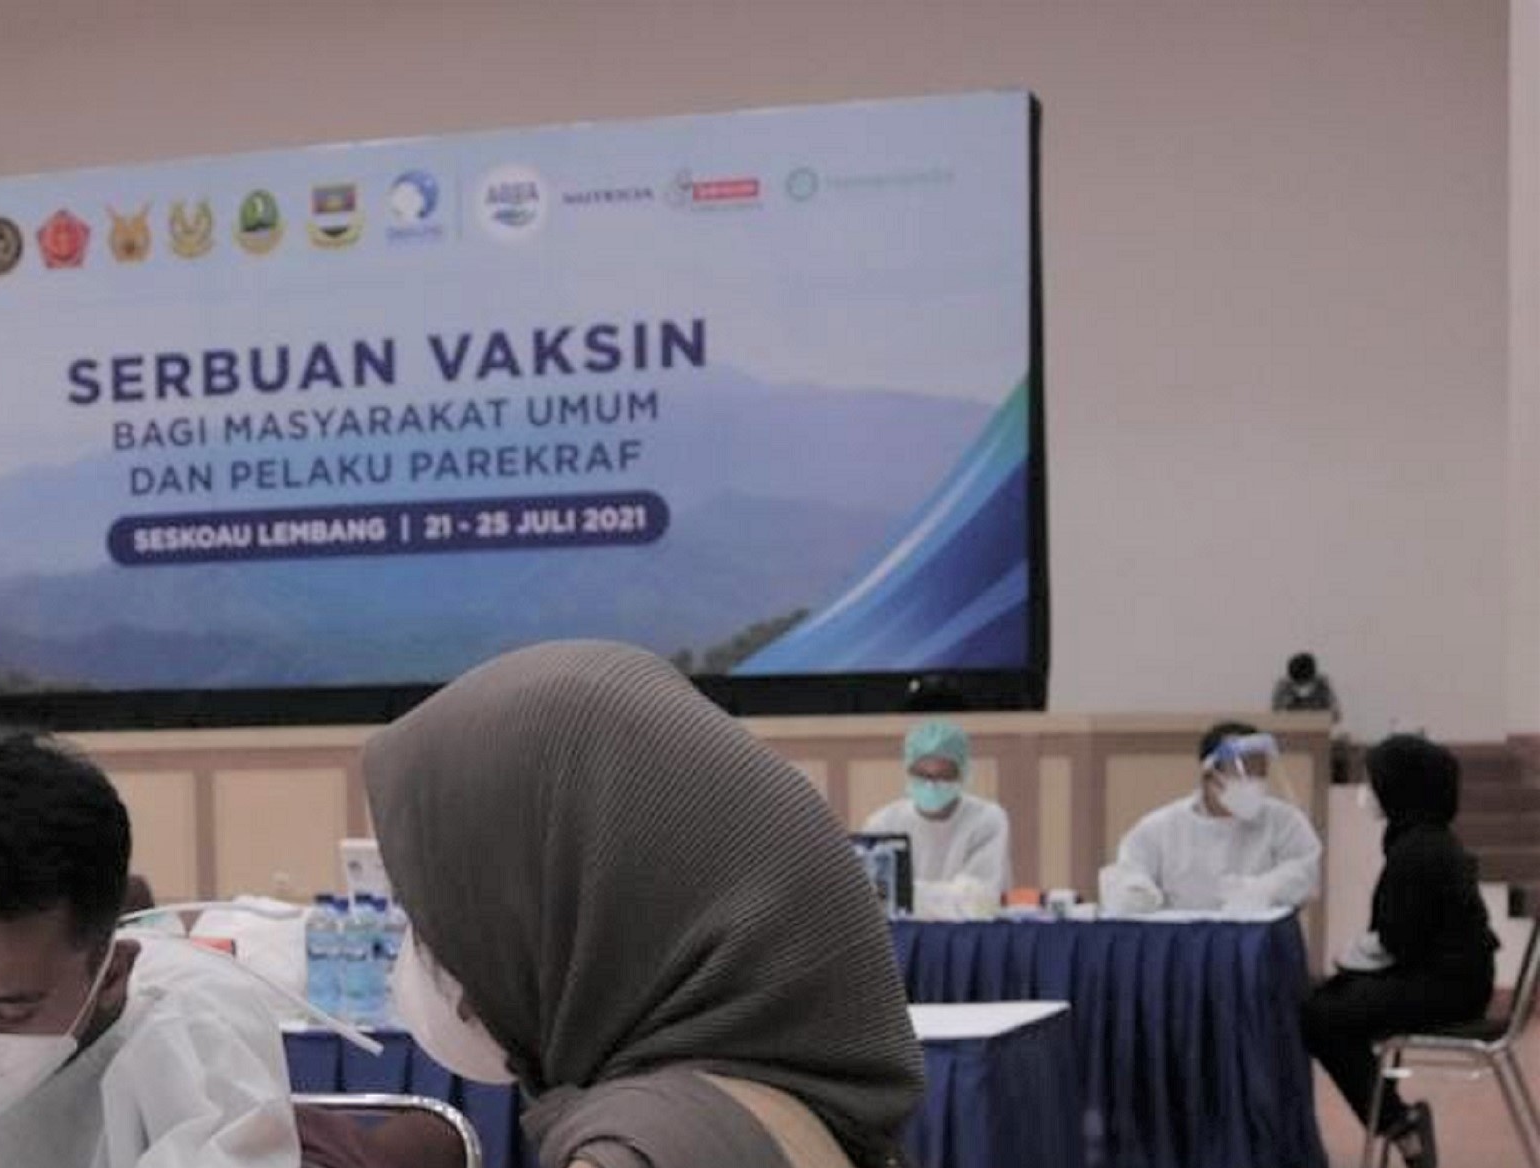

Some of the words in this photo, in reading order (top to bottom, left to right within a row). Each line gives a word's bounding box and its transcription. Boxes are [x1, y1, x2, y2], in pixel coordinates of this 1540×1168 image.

[68, 338, 396, 405] SERBUAN
[427, 318, 706, 382] VAKSIN
[113, 416, 207, 451] BAGI
[224, 398, 506, 445] MASYARAKAT
[527, 389, 658, 427] UMUM
[130, 464, 212, 496] DAN
[230, 453, 392, 490] PELAKU
[411, 440, 641, 482] PAREKRAF
[133, 524, 252, 552] SESKOAU
[258, 516, 386, 547] LEMBANG
[424, 515, 451, 539] 21
[475, 510, 509, 537] 25
[517, 508, 576, 534] JULI
[581, 505, 647, 532] 2021
